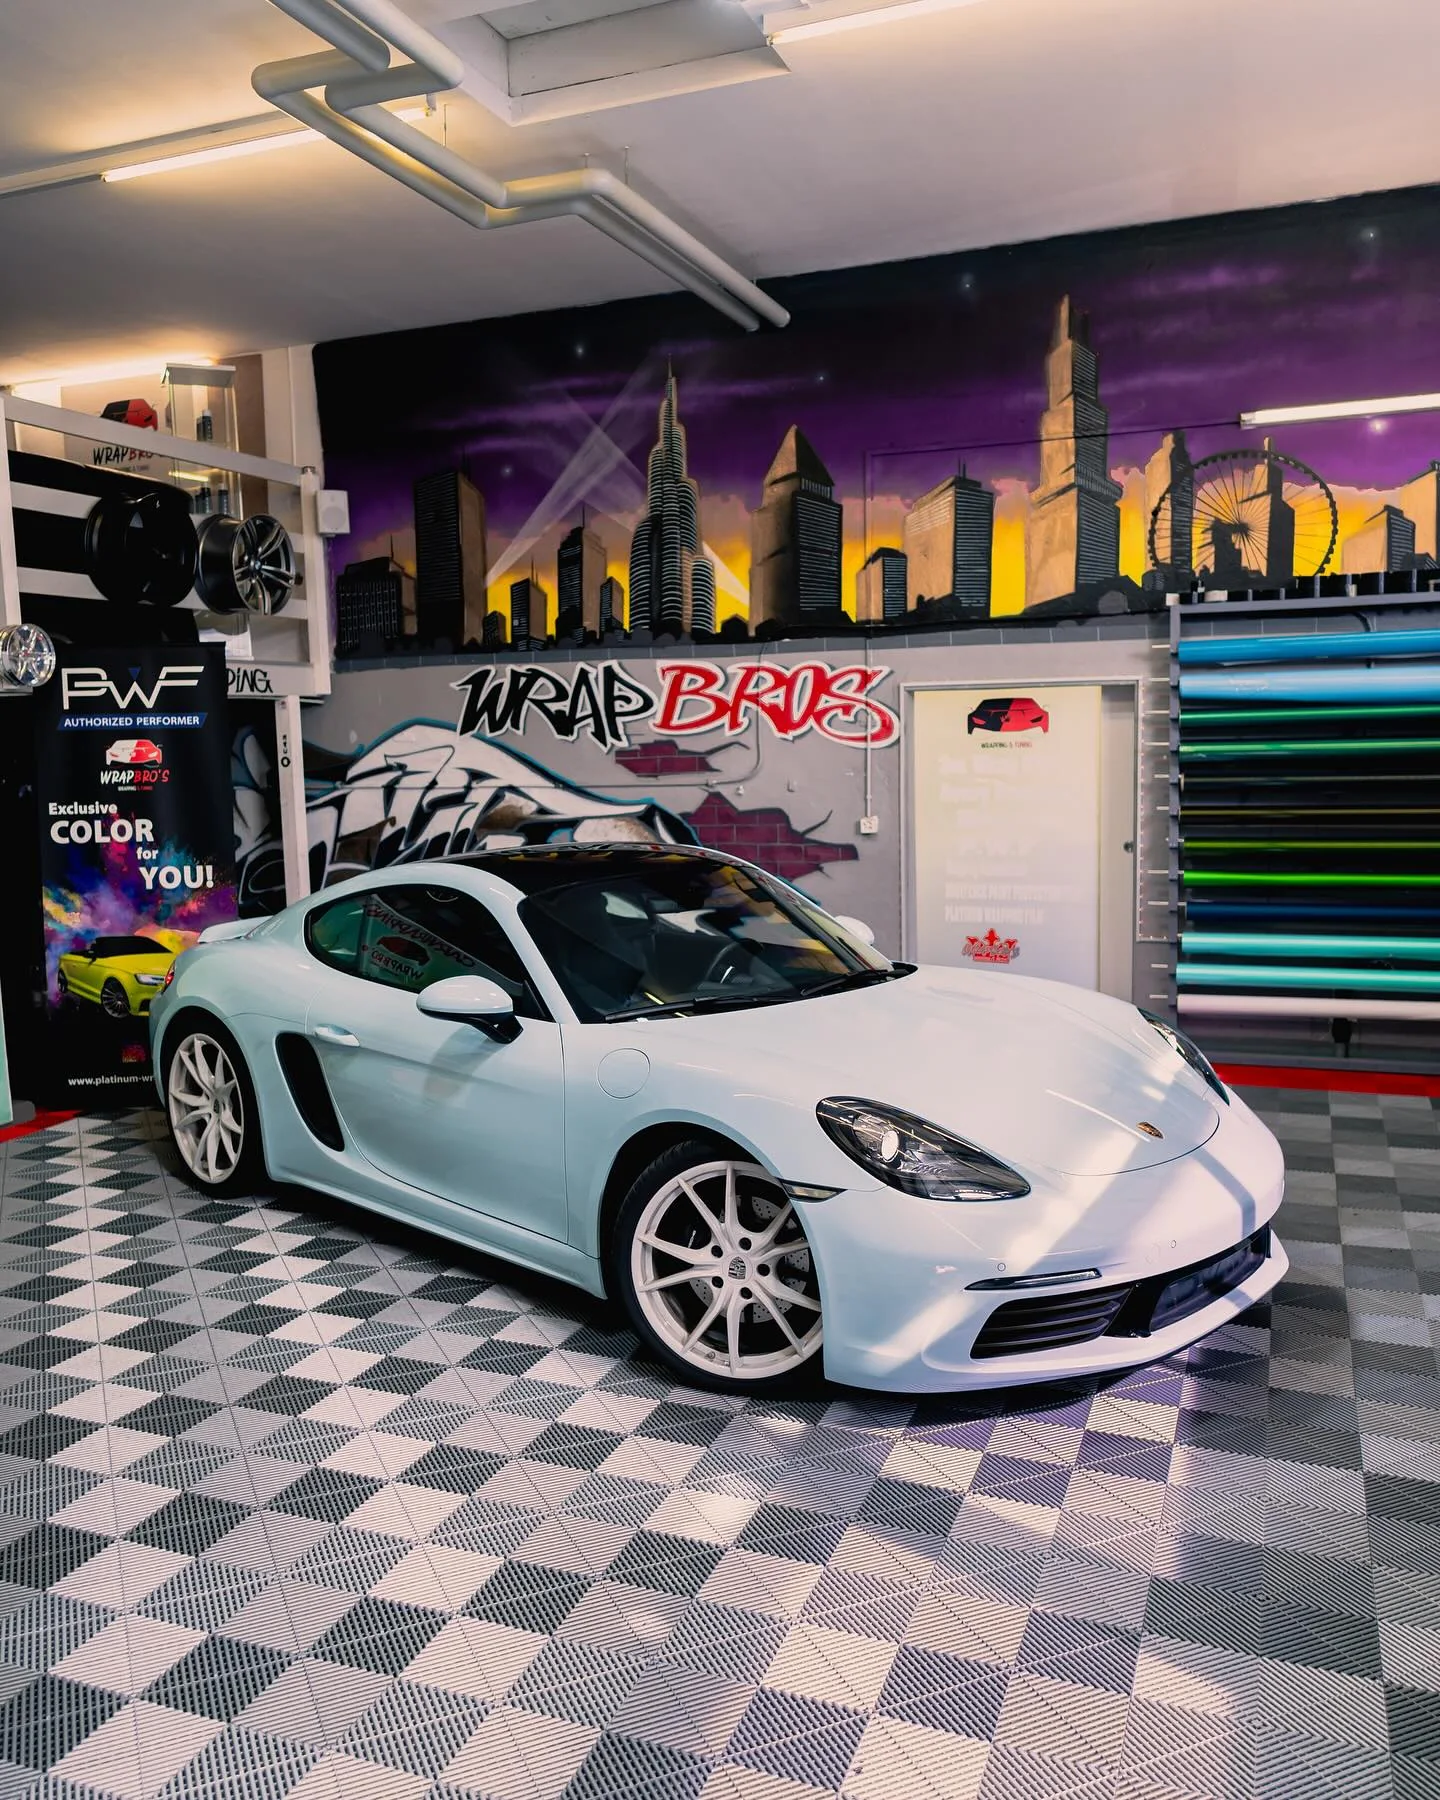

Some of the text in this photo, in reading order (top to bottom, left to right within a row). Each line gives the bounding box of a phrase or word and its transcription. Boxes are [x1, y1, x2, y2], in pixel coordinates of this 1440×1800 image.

[450, 659, 901, 753] WRAP BROS
[64, 715, 200, 727] AUTHORIZED PERFORMER
[100, 769, 170, 784] WRAPBRO'S
[48, 801, 118, 816] Exclusive
[50, 818, 154, 844] COLOR
[136, 846, 158, 860] for
[139, 864, 215, 890] YOU!
